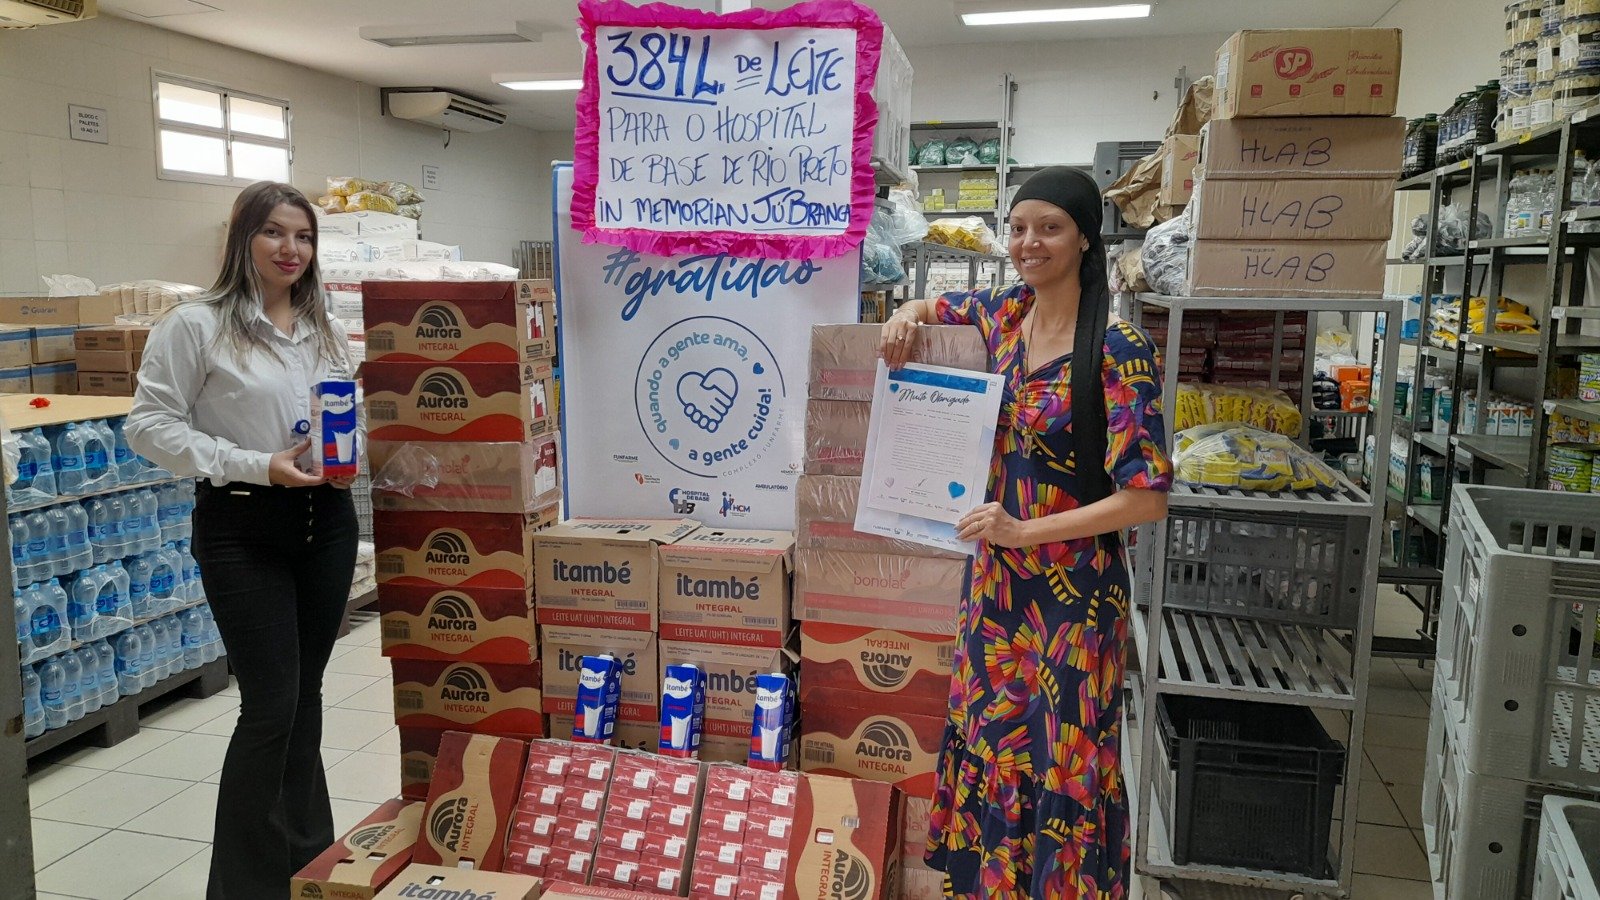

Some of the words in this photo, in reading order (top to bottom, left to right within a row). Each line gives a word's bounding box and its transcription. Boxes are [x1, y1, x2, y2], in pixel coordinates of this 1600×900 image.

[607, 107, 670, 146] PARA
[686, 114, 705, 142] O
[713, 102, 826, 142] HOSPITAL
[1240, 137, 1332, 167] HLAB
[610, 156, 635, 184] DE
[642, 153, 709, 186] BASE
[722, 156, 745, 185] DE
[747, 146, 787, 187] RIO
[790, 145, 847, 186] PRETO
[599, 197, 622, 223] IN
[632, 197, 749, 227] MEMORIAN
[1241, 195, 1344, 230] HLAB
[1244, 252, 1335, 282] HLAB
[415, 325, 462, 339] Aurora
[418, 343, 460, 351] INTEGRAL
[646, 369, 667, 433] quando
[658, 356, 670, 369] a
[668, 332, 710, 361] gente
[416, 395, 469, 409] Aurora
[899, 389, 927, 402] Muito
[930, 390, 970, 407] Obrigado
[420, 412, 466, 422] INTEGRAL
[688, 450, 698, 461] a
[703, 438, 749, 467] gente
[747, 388, 772, 440] cuida!
[722, 453, 763, 477] COMPLEXO
[692, 535, 775, 544] itambé
[425, 551, 470, 564] Aurora
[428, 567, 468, 576] INTEGRAL
[553, 559, 631, 584] itambé
[571, 588, 615, 597] INTEGRAL
[676, 573, 760, 600] itambé
[696, 603, 743, 613] INTEGRAL
[428, 617, 477, 631] Aurora
[552, 612, 569, 621] LEITE
[570, 614, 583, 622] UAT
[583, 615, 602, 624] (UHT)
[604, 617, 636, 626] INTEGRAL
[431, 633, 474, 643] INTEGRAL
[675, 628, 693, 637] LEITE
[695, 629, 708, 638] UAT
[709, 630, 729, 640] (UHT)
[731, 631, 764, 643] INTEGRAL
[864, 638, 910, 651] INTEGRAL
[861, 651, 912, 668] Aurora
[440, 687, 490, 702] Aurora
[667, 683, 688, 692] itambé
[444, 704, 488, 714] INTEGRAL
[557, 702, 574, 711] LEITE
[855, 741, 912, 761] Aurora
[858, 759, 908, 774] INTEGRAL
[445, 796, 468, 853] Aurora
[461, 803, 479, 852] INTEGRAL
[361, 825, 396, 851] Aurora
[376, 827, 405, 850] INTEGRAL
[818, 850, 832, 900] INTEGRA
[831, 849, 849, 900] Auror
[330, 891, 365, 900] INTEGRAL
